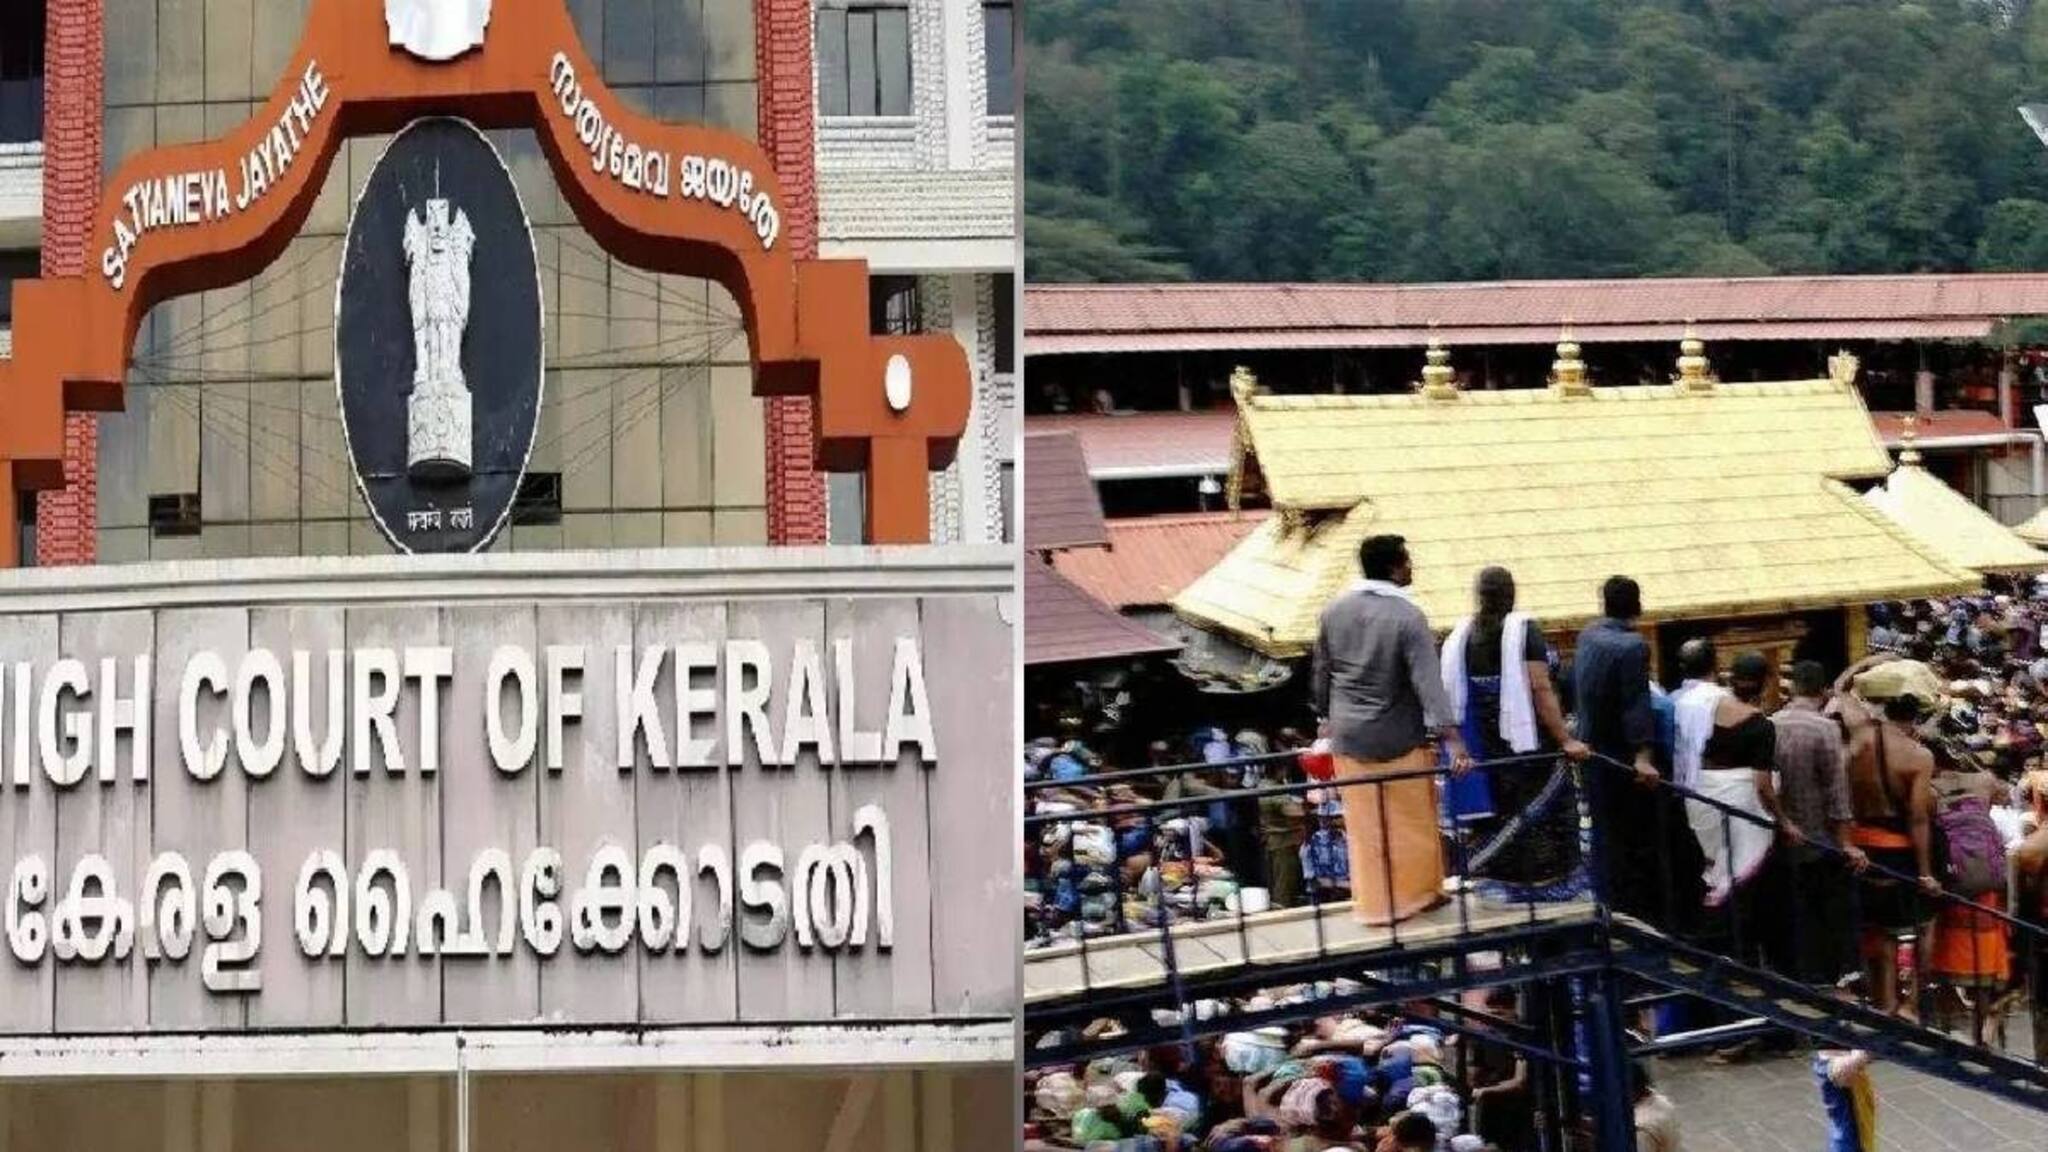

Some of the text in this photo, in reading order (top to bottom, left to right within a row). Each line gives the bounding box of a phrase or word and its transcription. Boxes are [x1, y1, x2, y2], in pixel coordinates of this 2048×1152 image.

[103, 59, 330, 290] SATYAMEVA JAYATHE
[551, 52, 780, 249] സത്യമേവ ജയതേ
[0, 637, 937, 785] IGH COURT OF KERALA
[5, 804, 893, 992] കേരള ഹൈക്കോടതി
